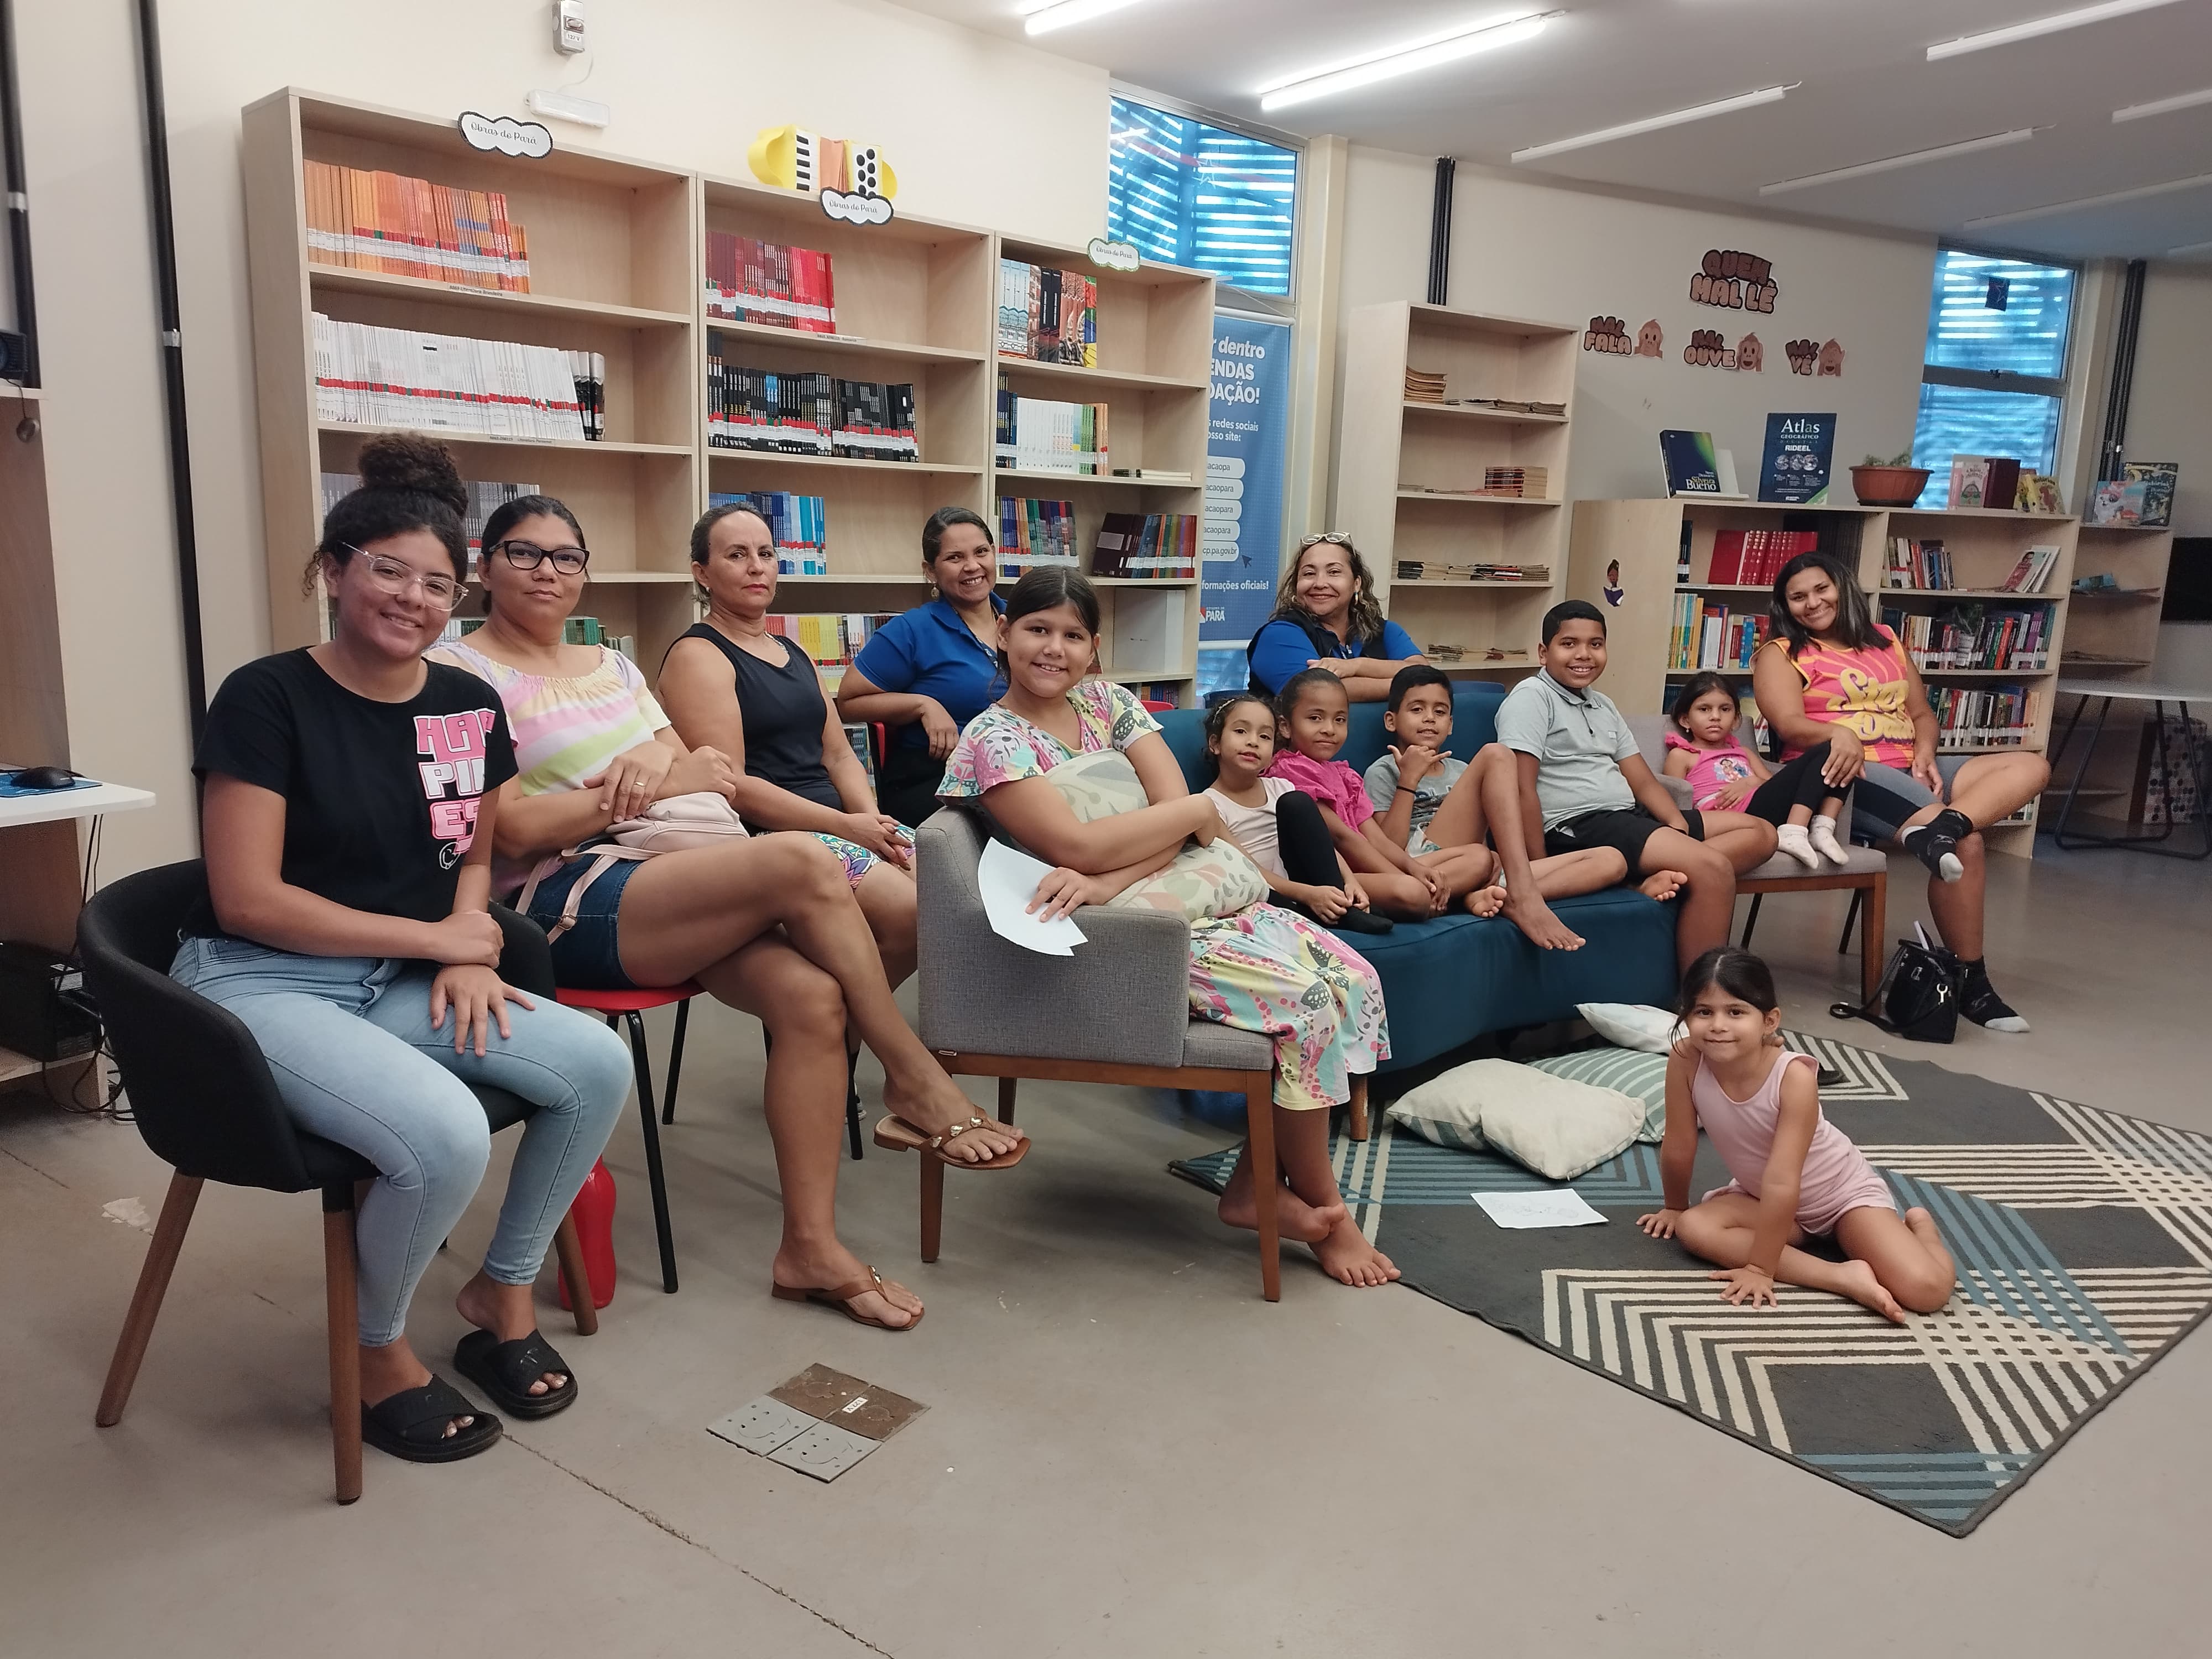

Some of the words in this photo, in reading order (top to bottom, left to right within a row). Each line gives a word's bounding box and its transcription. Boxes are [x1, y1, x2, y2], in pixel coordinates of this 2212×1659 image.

[471, 122, 498, 135] Obras
[500, 130, 512, 139] do
[513, 132, 538, 145] Pará
[829, 199, 849, 210] Obras
[860, 204, 878, 213] Pará
[1096, 246, 1112, 254] Obras
[1702, 249, 1772, 287] QUEM
[1690, 273, 1743, 310] MAL
[1745, 278, 1778, 314] LÊ
[1218, 336, 1265, 359] dentro
[1584, 331, 1632, 355] FALA
[1684, 345, 1735, 368] OUVE
[1790, 354, 1812, 375] VÊ
[1213, 418, 1234, 429] redes
[1235, 420, 1259, 431] sociais
[1781, 418, 1820, 433] Atlas
[1225, 431, 1241, 441] site:
[1207, 463, 1230, 472] acaopa
[1686, 478, 1717, 491] Bueno
[1691, 476, 1715, 484] Silveira
[1206, 484, 1234, 493] acaopara
[1204, 505, 1233, 514] acaopara
[1203, 526, 1231, 536] acaopara
[1202, 547, 1237, 557] cp.pa.gov.br
[1202, 580, 1239, 592] formações
[1240, 580, 1269, 590] oficiais!
